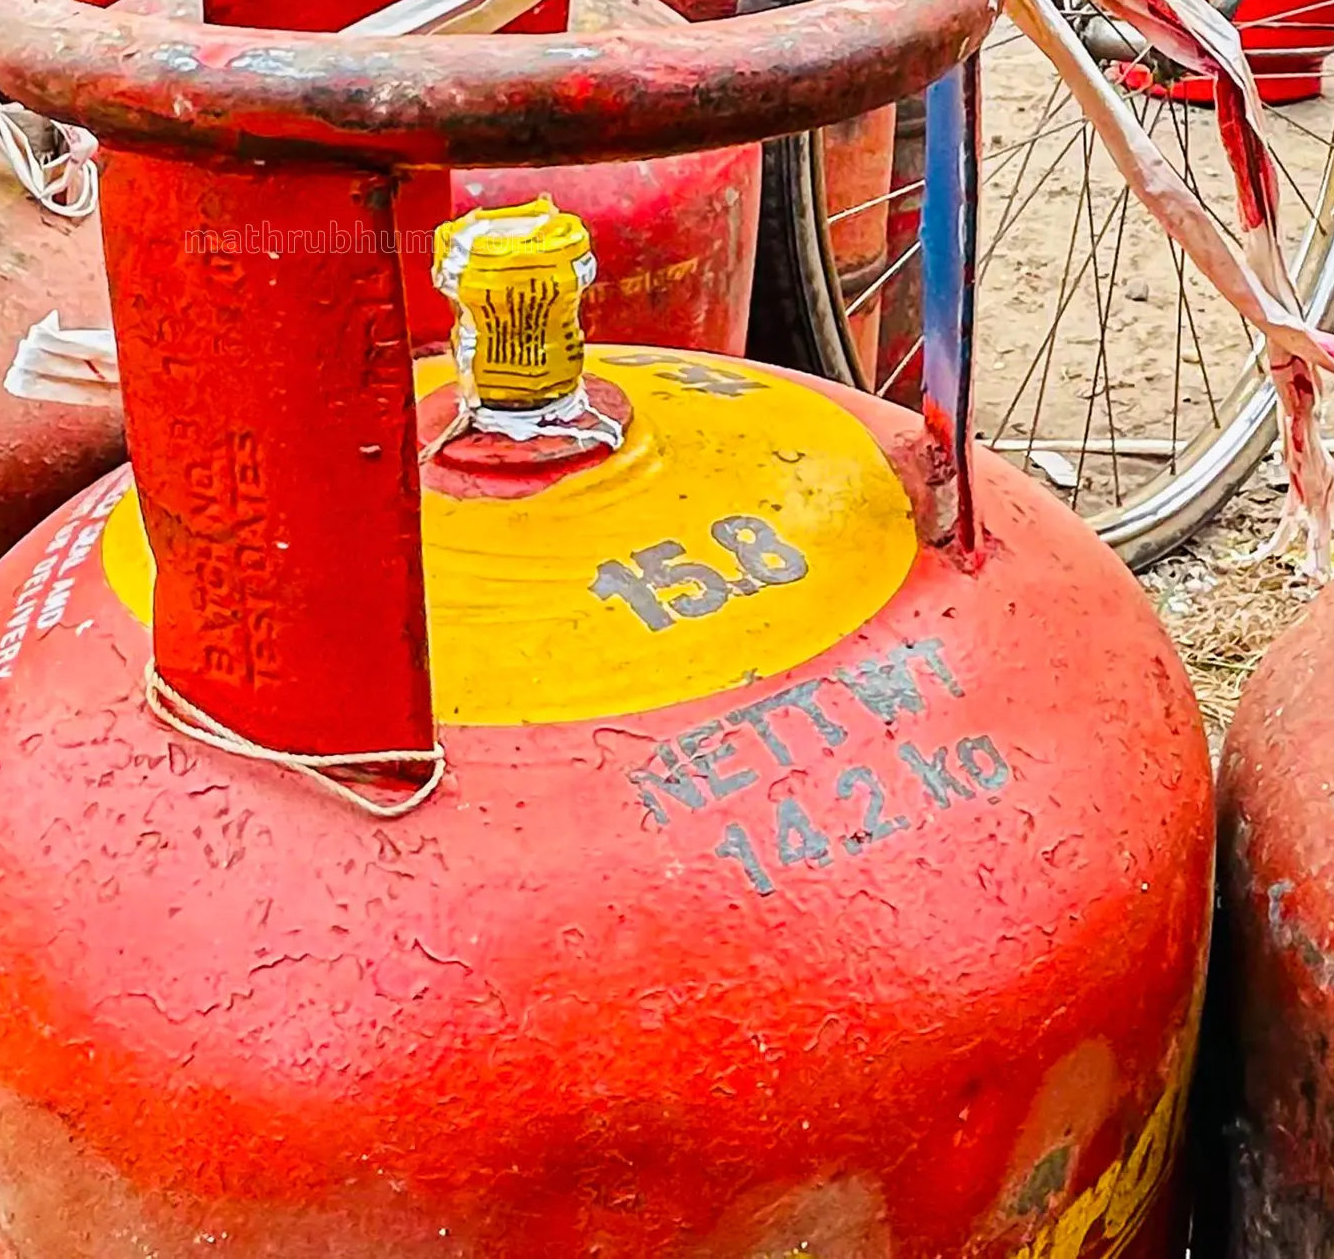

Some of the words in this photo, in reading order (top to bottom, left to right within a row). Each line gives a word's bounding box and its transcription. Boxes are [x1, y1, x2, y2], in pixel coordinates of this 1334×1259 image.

[587, 515, 809, 631] 15.8
[627, 678, 848, 826] NETT
[833, 637, 965, 726] WT
